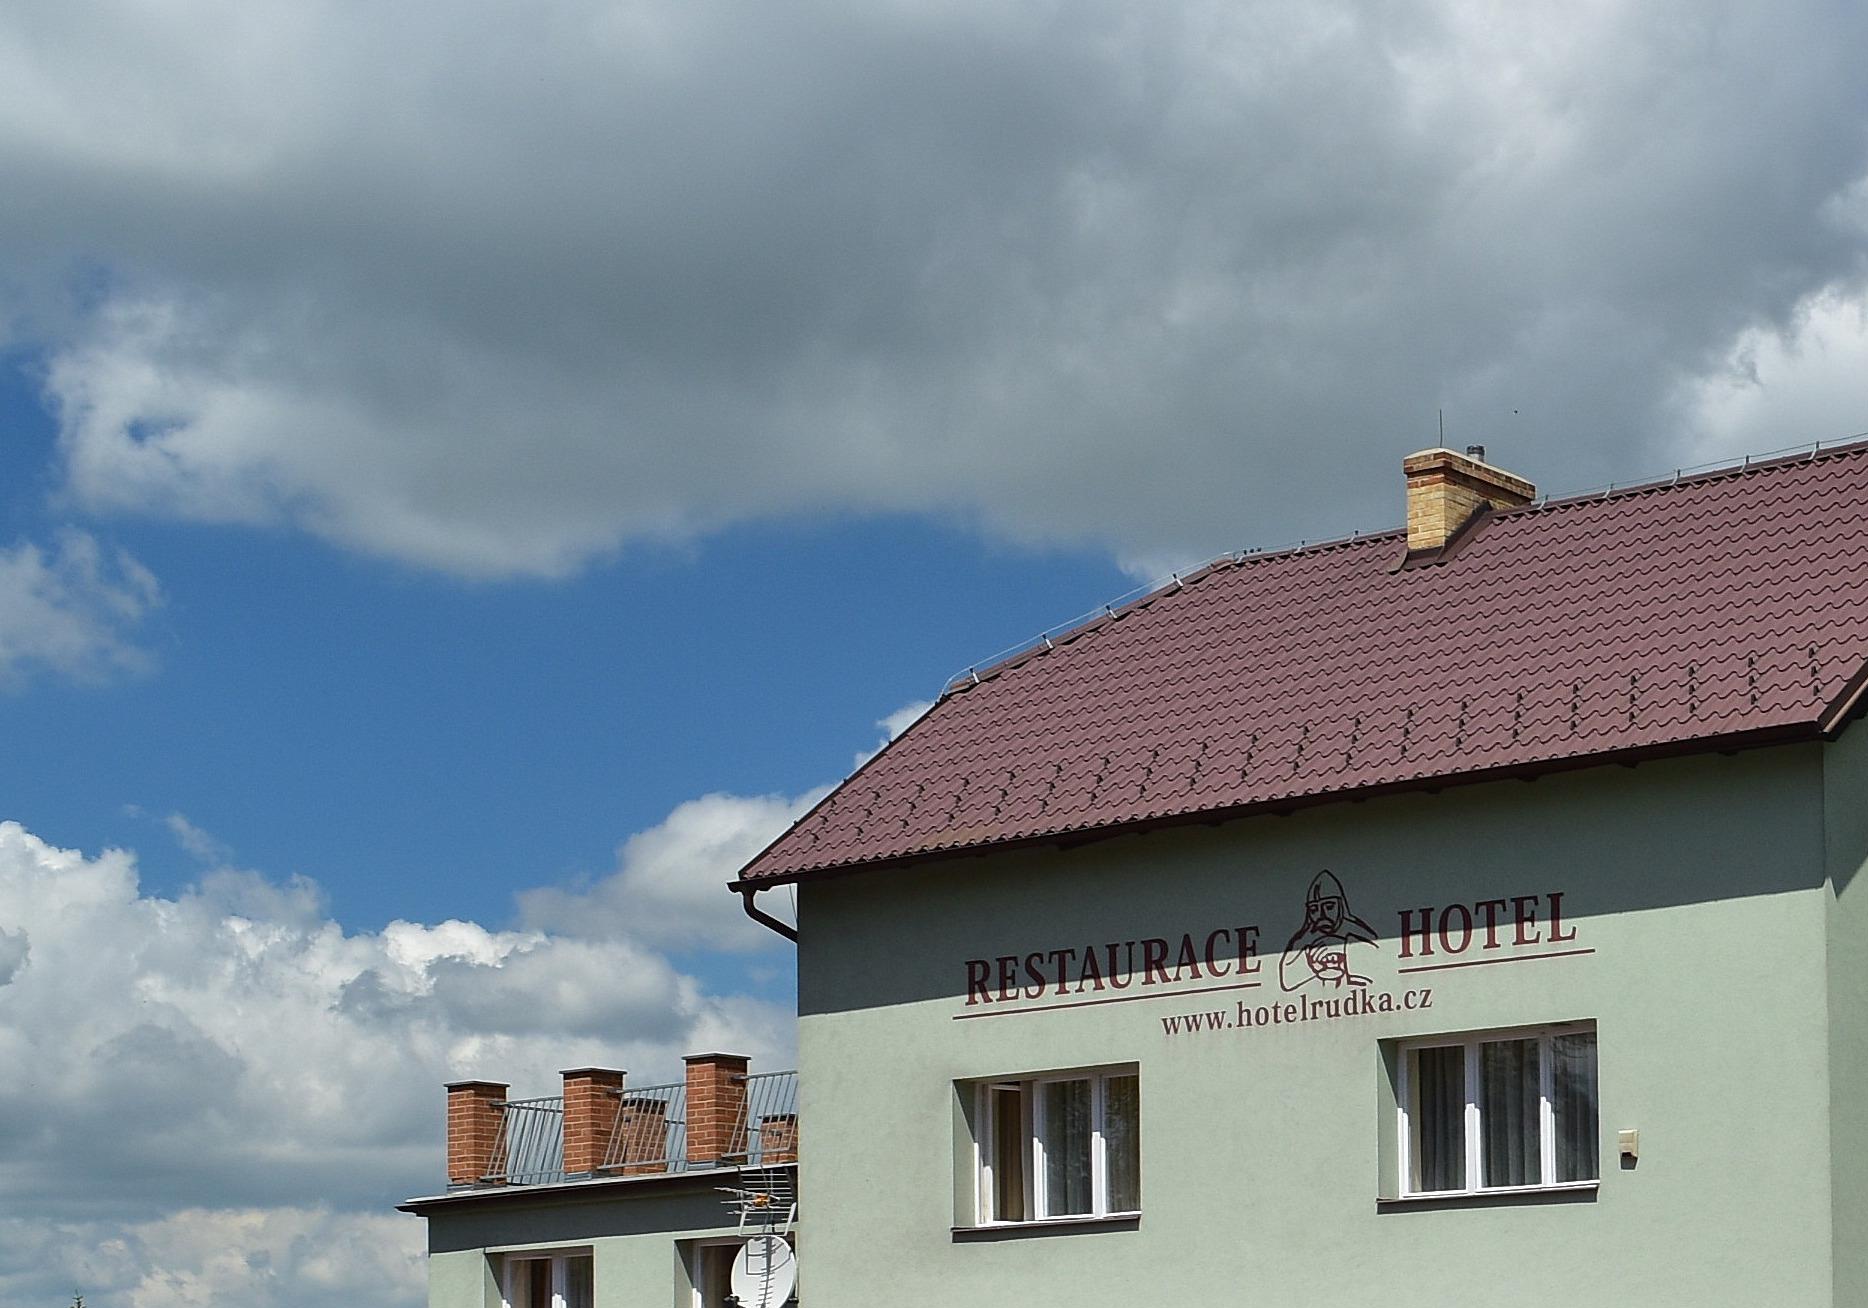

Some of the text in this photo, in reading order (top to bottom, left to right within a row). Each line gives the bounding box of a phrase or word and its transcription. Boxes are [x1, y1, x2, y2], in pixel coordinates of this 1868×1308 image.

[965, 892, 1577, 1007] RESTAURACE HOTEL
[1161, 988, 1433, 1035] www.hotelrudka.cz
